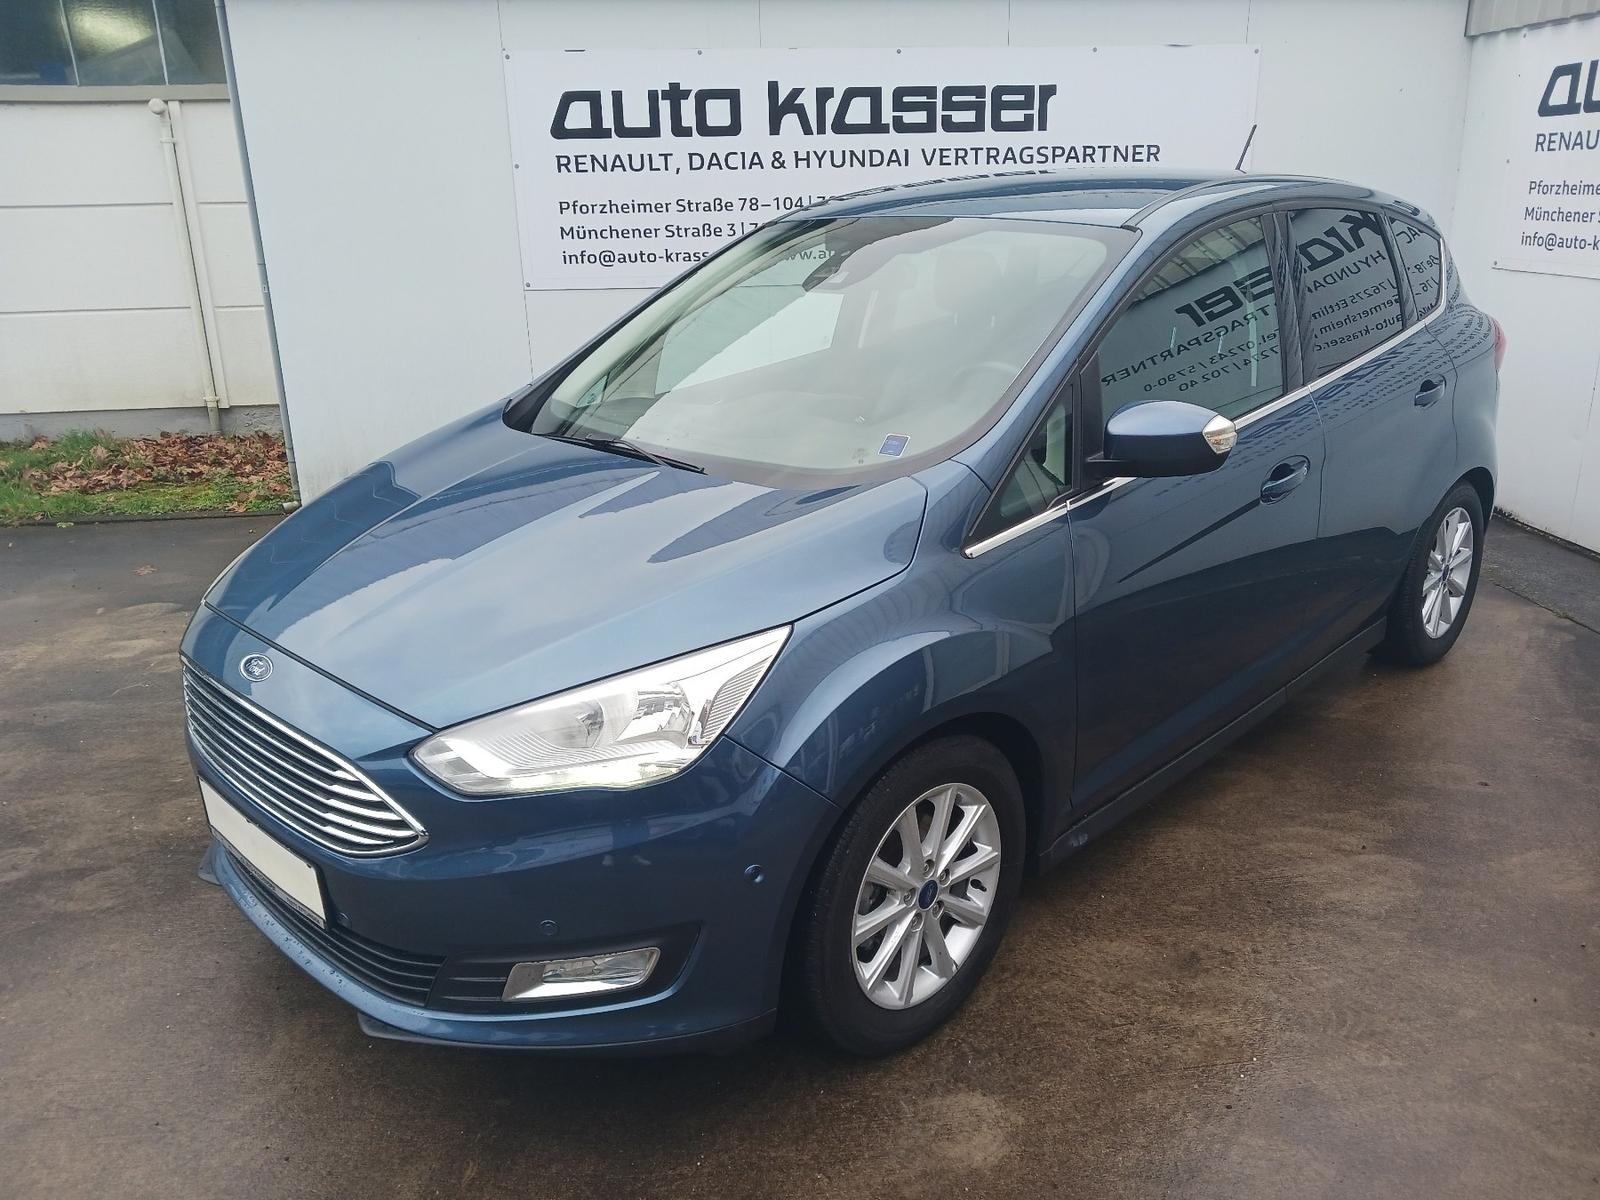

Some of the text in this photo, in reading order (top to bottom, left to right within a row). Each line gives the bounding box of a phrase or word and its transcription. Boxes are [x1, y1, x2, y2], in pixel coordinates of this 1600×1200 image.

[550, 80, 1057, 140] auto krasser
[555, 144, 1161, 175] RENAULT, DACIA & HYUNDAI VERTRAGSPARTNER
[558, 199, 672, 215] Pforzheimer
[675, 198, 734, 213] Straße
[1523, 206, 1596, 224] Münchener
[559, 225, 661, 240] Münchener
[664, 224, 723, 238] Straße
[726, 222, 736, 237] 3
